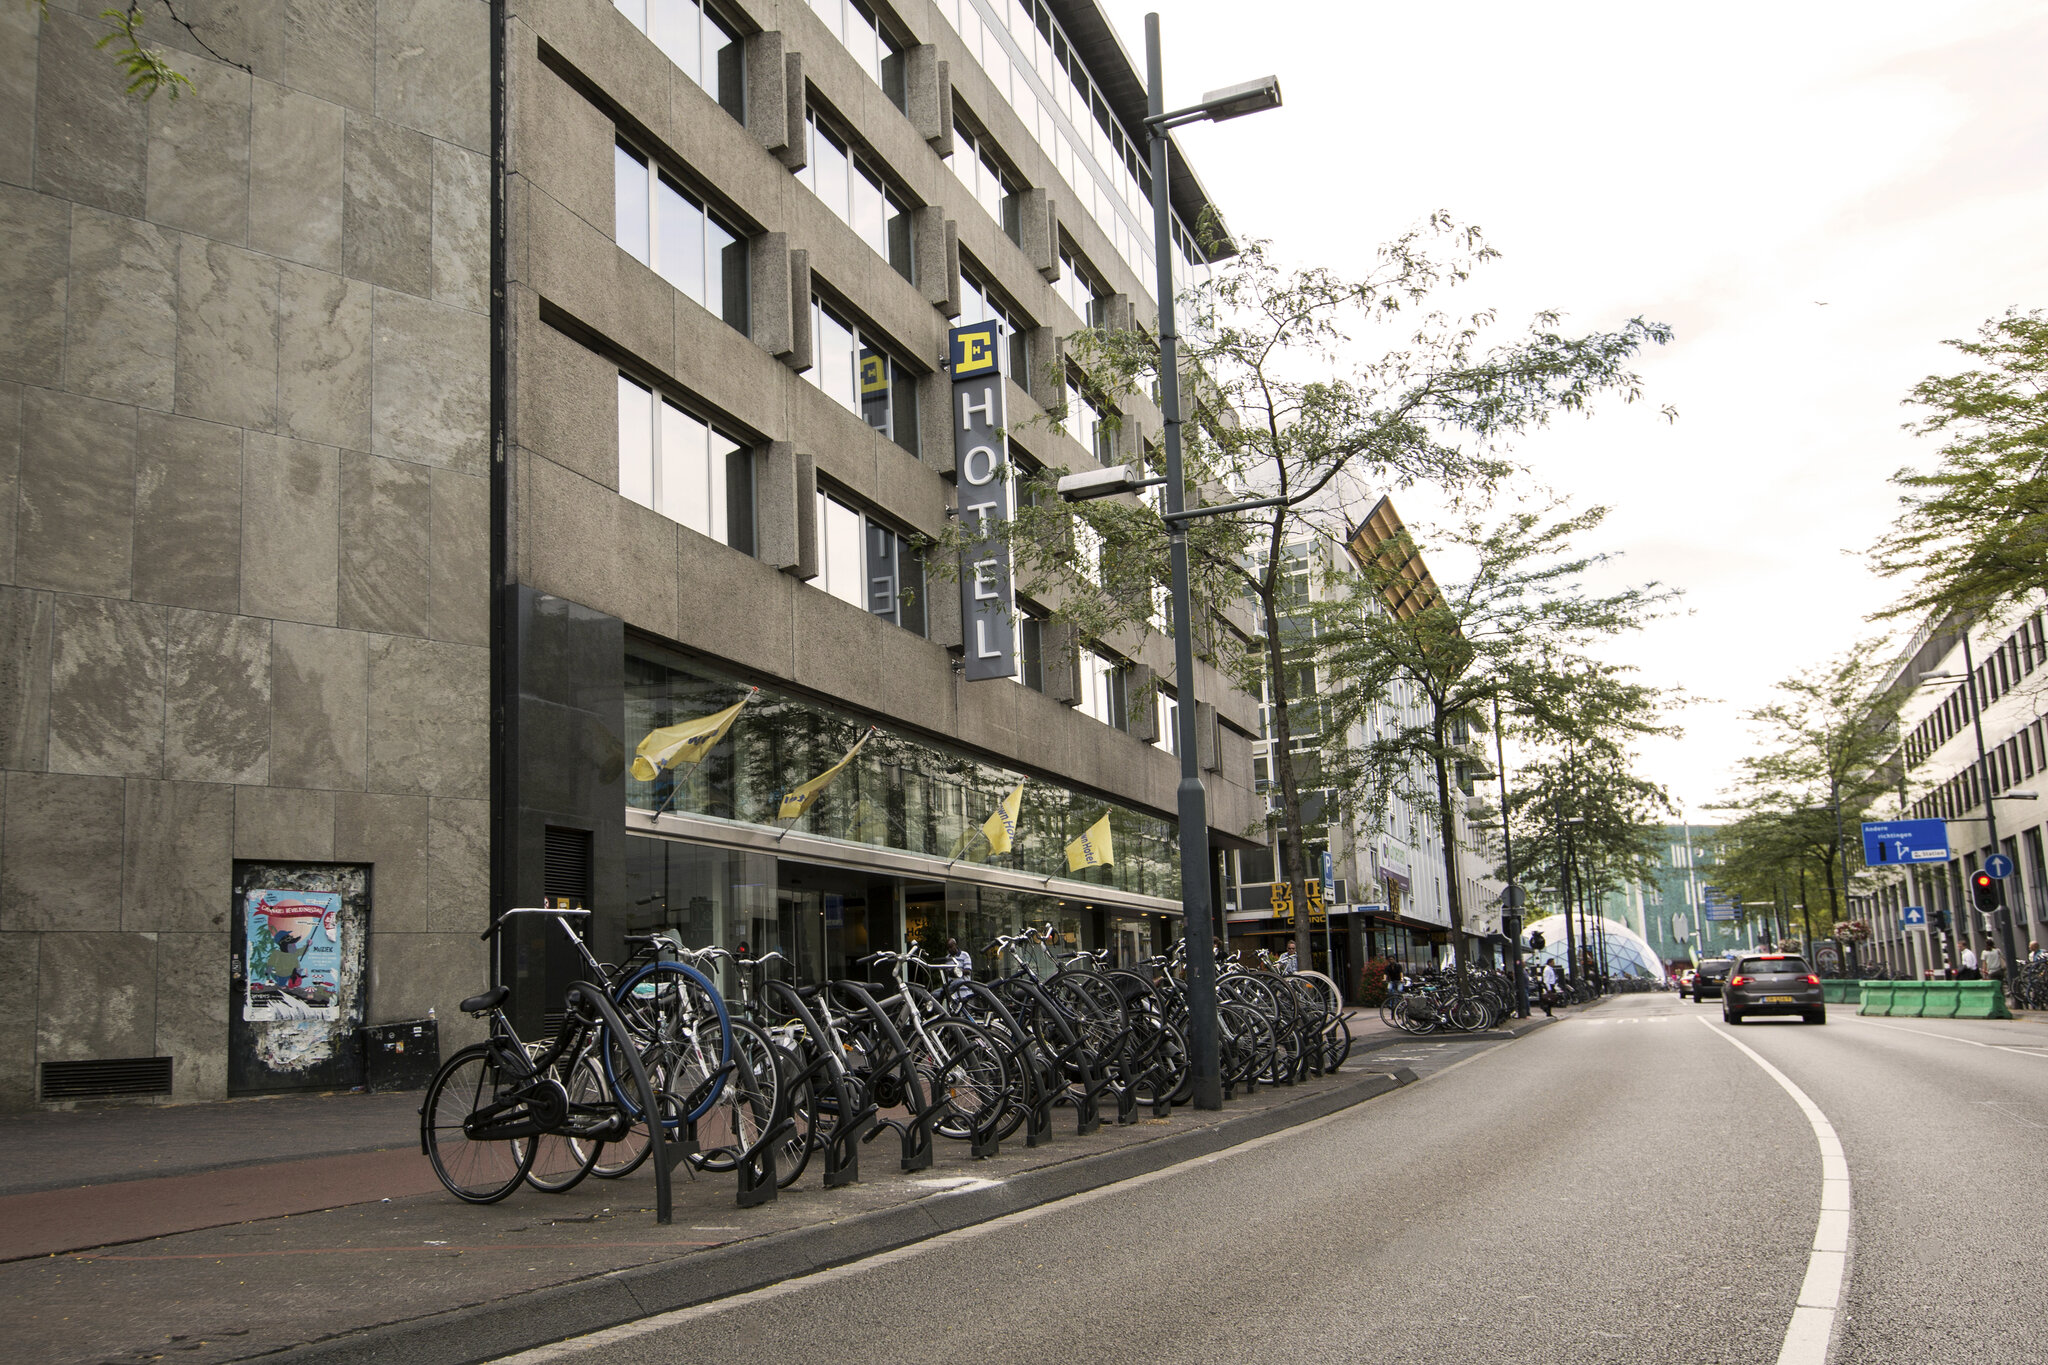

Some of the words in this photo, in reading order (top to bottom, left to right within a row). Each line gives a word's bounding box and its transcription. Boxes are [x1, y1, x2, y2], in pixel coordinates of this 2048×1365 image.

[962, 387, 1002, 659] HOTEL
[1082, 842, 1097, 865] Hotel
[1325, 855, 1331, 873] P
